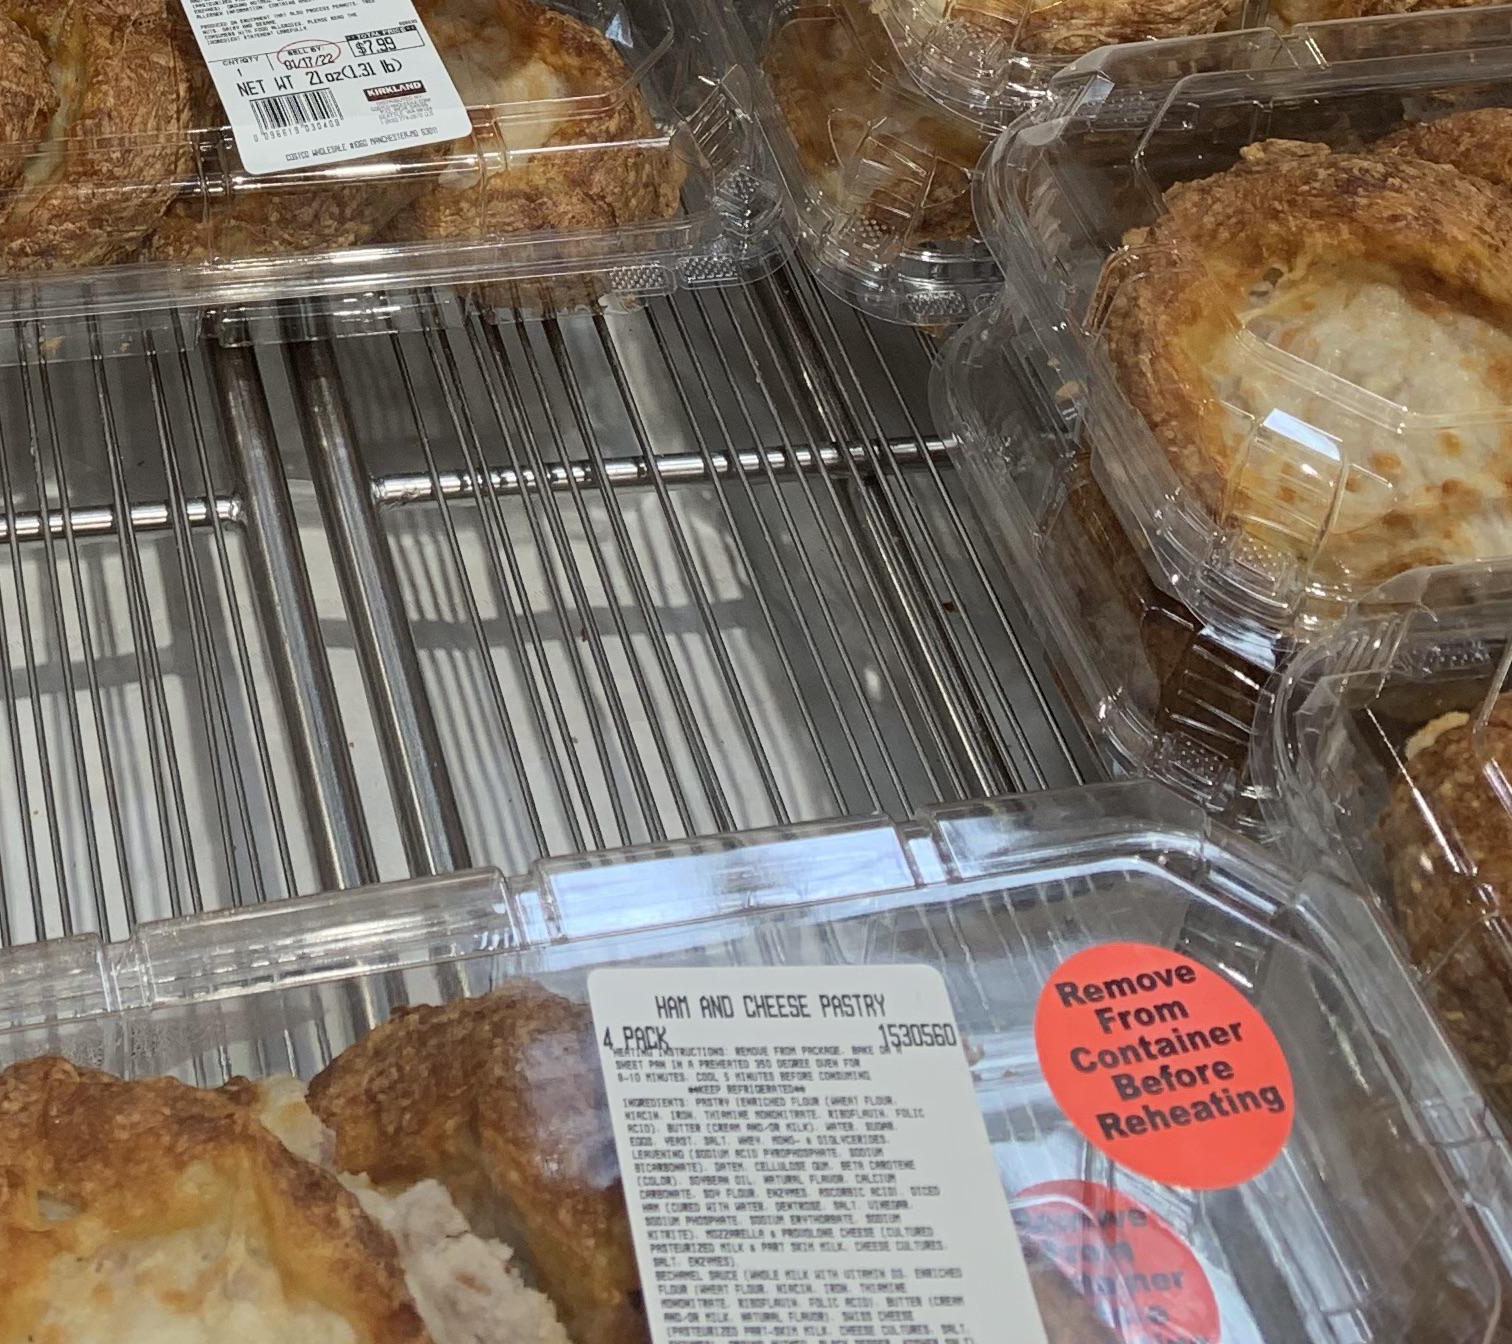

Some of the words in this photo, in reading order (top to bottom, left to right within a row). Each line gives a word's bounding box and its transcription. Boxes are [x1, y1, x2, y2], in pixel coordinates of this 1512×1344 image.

[367, 81, 422, 99] KIRKLAND
[655, 996, 690, 1018] HAM
[701, 996, 734, 1018] AND
[745, 995, 811, 1018] CHEESE
[821, 994, 886, 1017] PASTRY
[1054, 963, 1197, 1009] Remove
[878, 1024, 956, 1048] 1530560
[1094, 996, 1190, 1036] From
[603, 1028, 613, 1047] 4
[623, 1026, 669, 1049] PACK
[1069, 1020, 1243, 1073] Container
[1111, 1060, 1235, 1102] Before
[1096, 1084, 1286, 1141] Reheating
